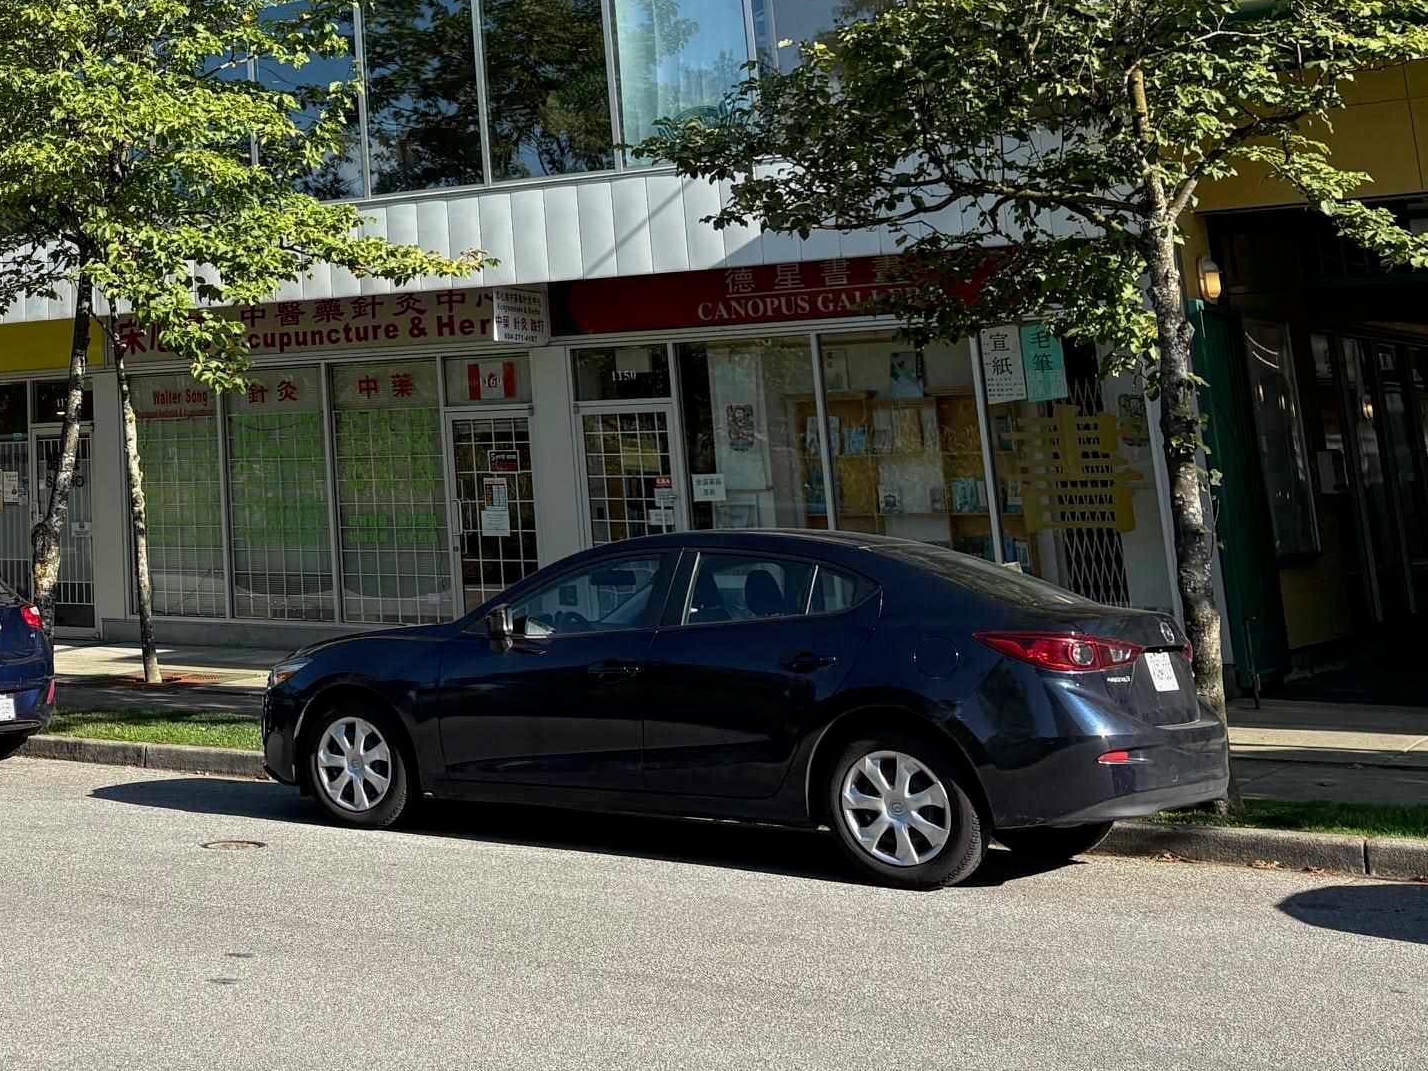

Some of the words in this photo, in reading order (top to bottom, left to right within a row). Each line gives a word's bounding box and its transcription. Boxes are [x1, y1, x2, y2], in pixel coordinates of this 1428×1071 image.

[697, 295, 811, 321] CANOPUS
[247, 322, 400, 353] cupuncture
[409, 315, 428, 338] &
[436, 314, 492, 338] Her
[154, 390, 181, 405] Walter
[186, 389, 207, 406] Song
[248, 379, 299, 403] 針灸
